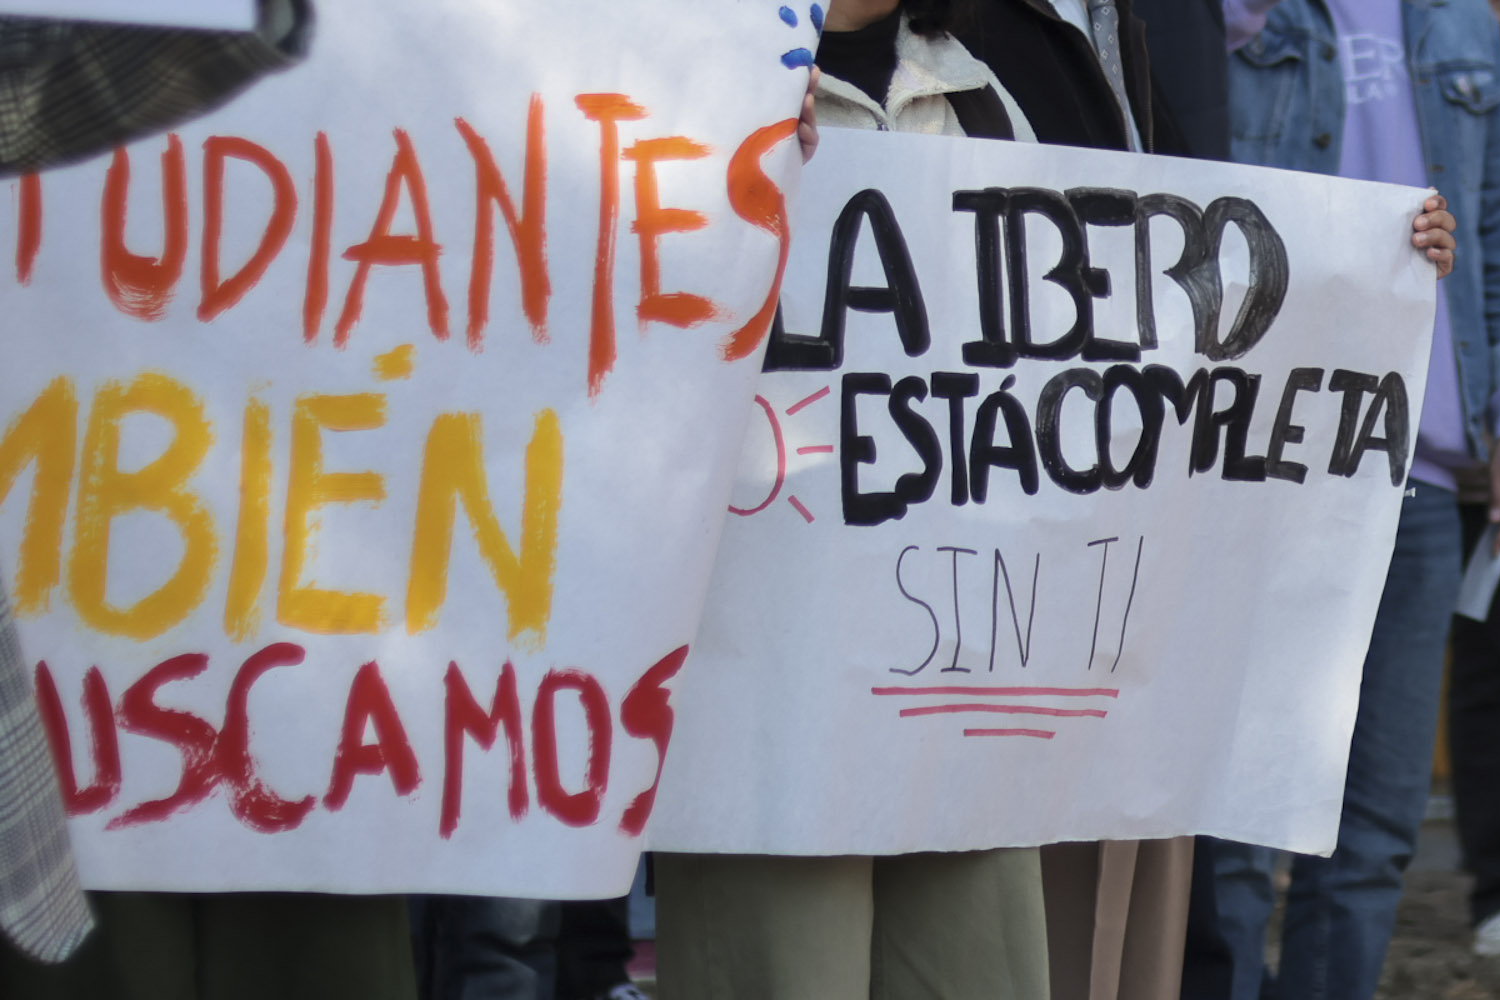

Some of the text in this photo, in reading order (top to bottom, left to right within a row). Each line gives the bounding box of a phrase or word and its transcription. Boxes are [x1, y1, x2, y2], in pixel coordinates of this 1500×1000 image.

[952, 186, 1290, 369] IBERO
[889, 535, 1144, 677] SIN TI
